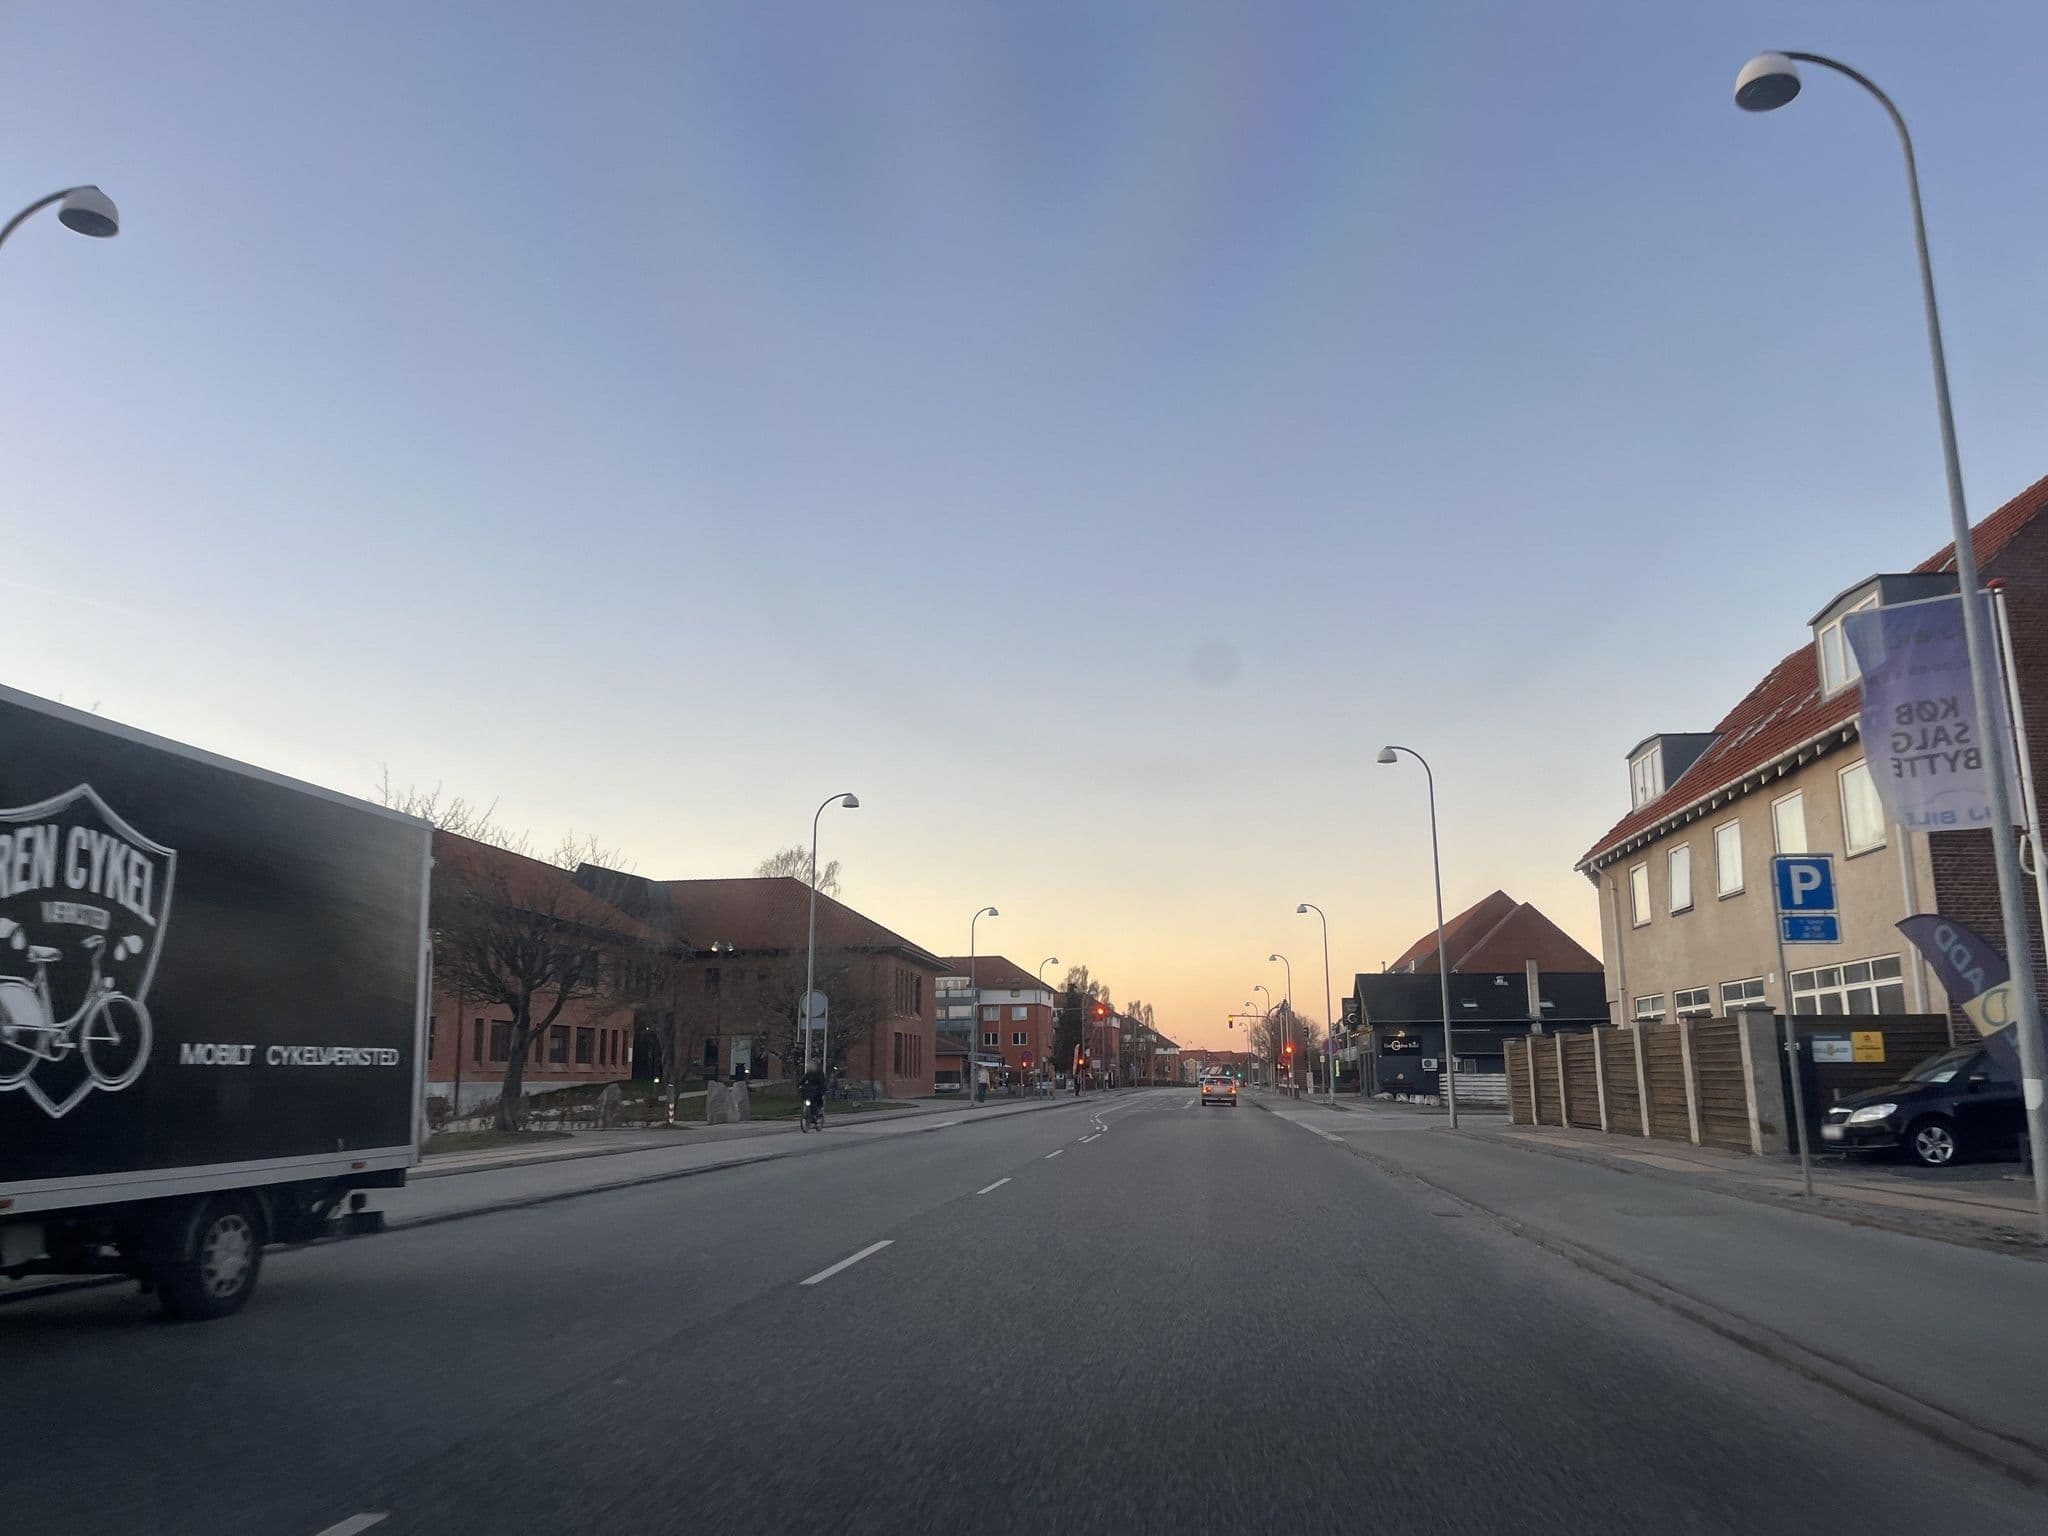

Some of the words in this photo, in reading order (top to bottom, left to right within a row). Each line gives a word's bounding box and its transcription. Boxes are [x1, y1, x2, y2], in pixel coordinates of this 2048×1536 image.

[64, 826, 156, 926] CYKEL
[1790, 865, 1821, 905] P
[180, 1043, 256, 1065] MOBILT
